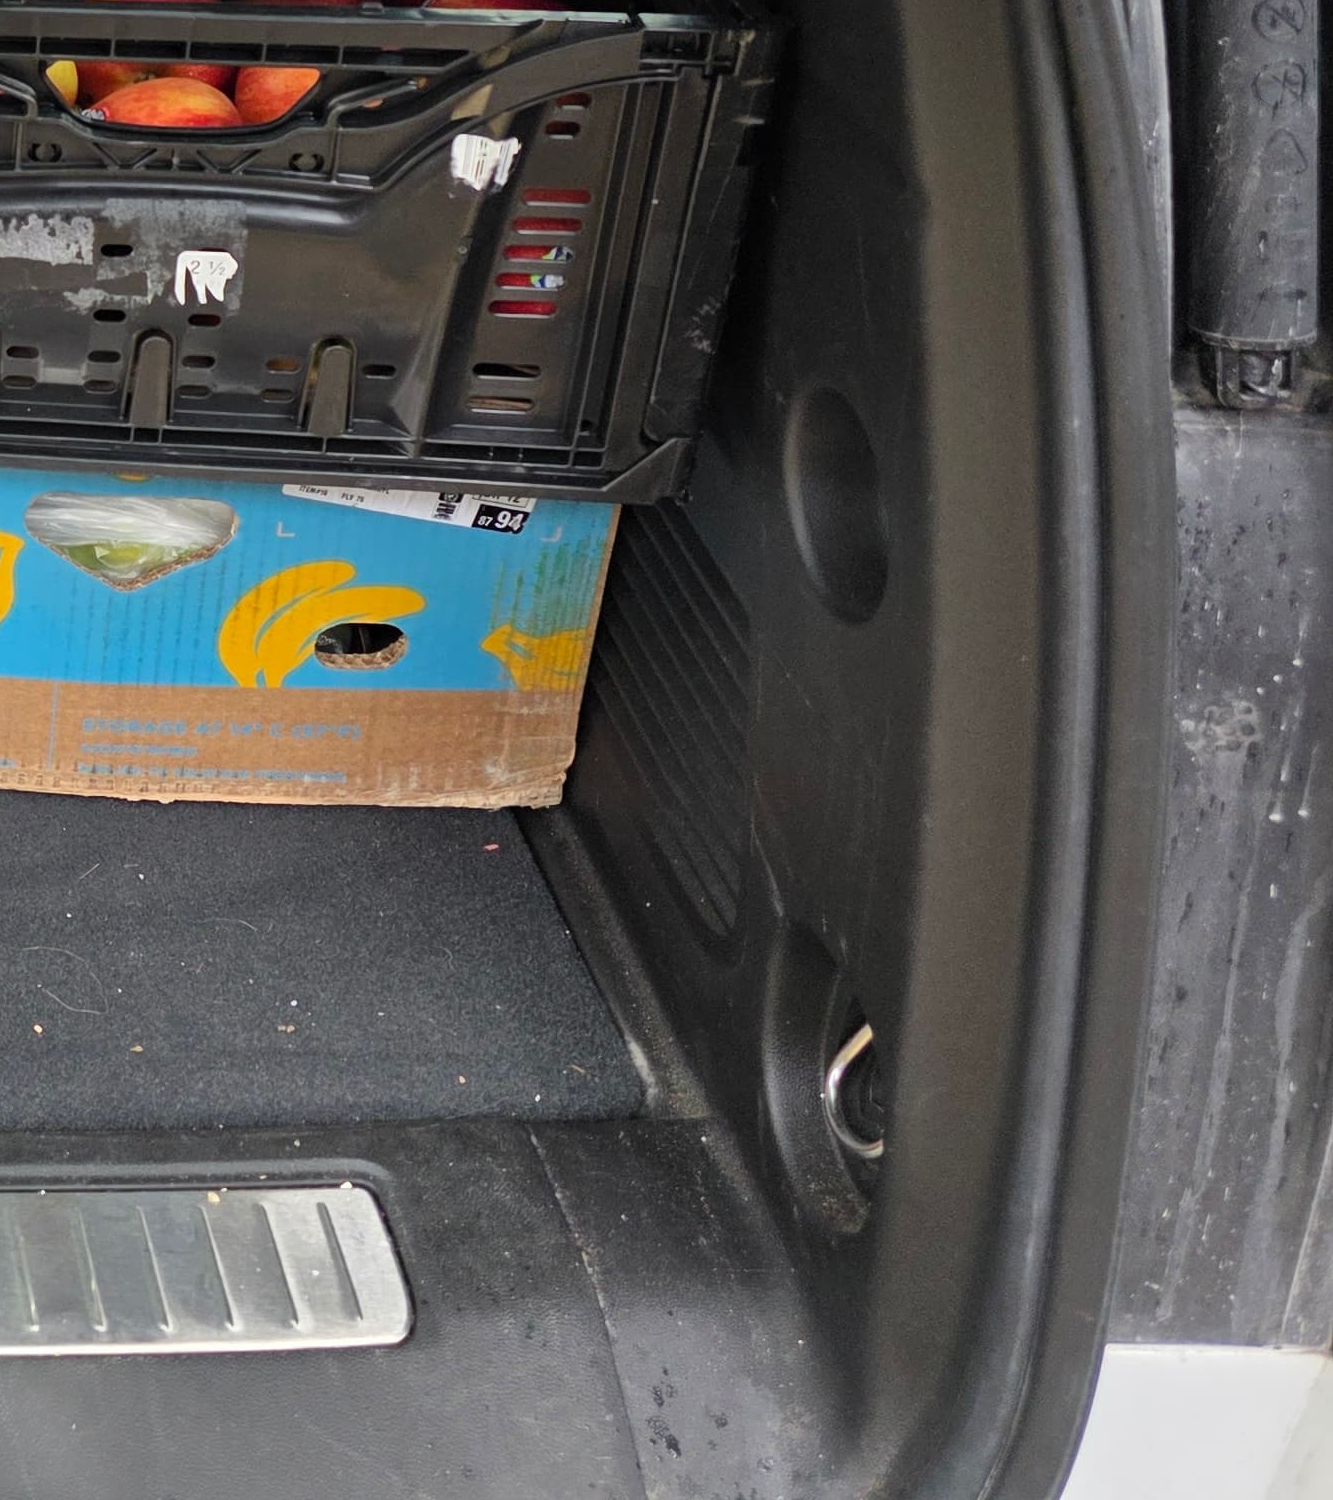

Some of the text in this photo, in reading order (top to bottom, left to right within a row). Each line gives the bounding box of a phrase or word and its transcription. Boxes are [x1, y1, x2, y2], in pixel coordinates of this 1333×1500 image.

[477, 510, 525, 532] 87 94
[83, 717, 187, 735] STORAGE
